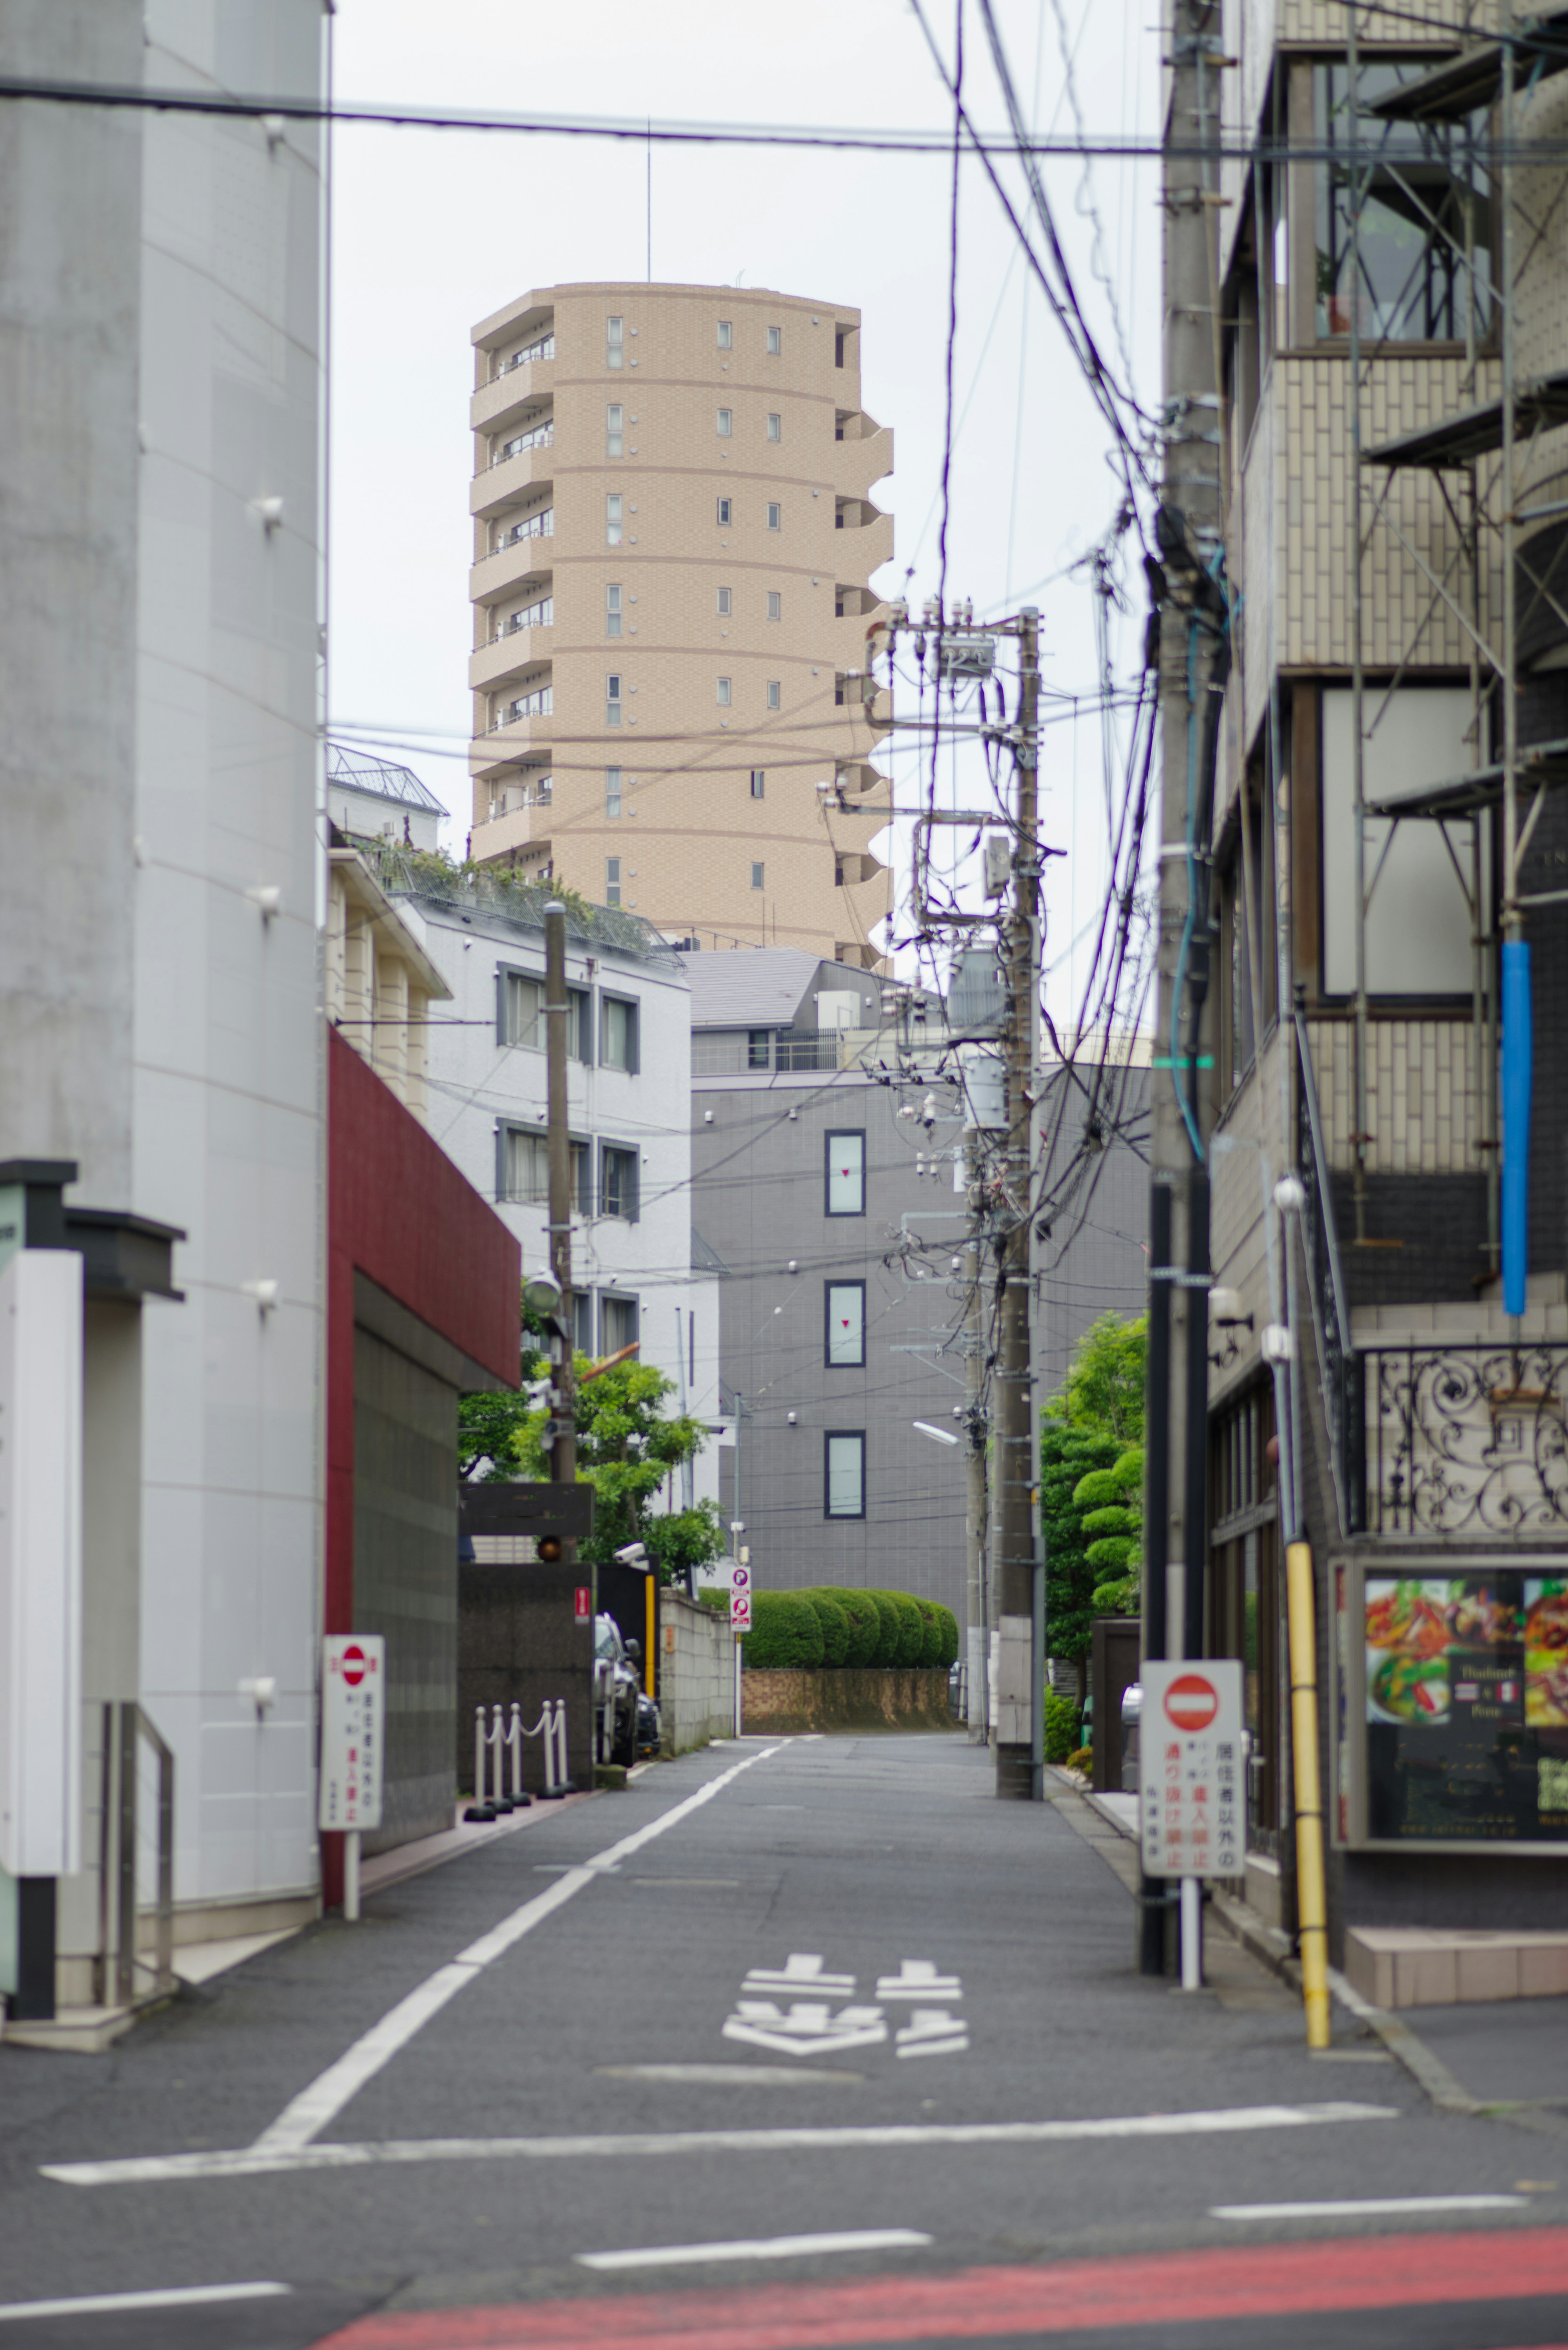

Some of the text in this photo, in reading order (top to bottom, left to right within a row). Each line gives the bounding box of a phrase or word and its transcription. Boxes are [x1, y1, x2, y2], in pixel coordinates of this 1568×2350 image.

[1460, 1664, 1516, 1679] Thailand
[1165, 1742, 1182, 1868] 通り抜け禁止
[1192, 1786, 1208, 1868] 進入禁止
[1217, 1743, 1234, 1868] 居住者以外の
